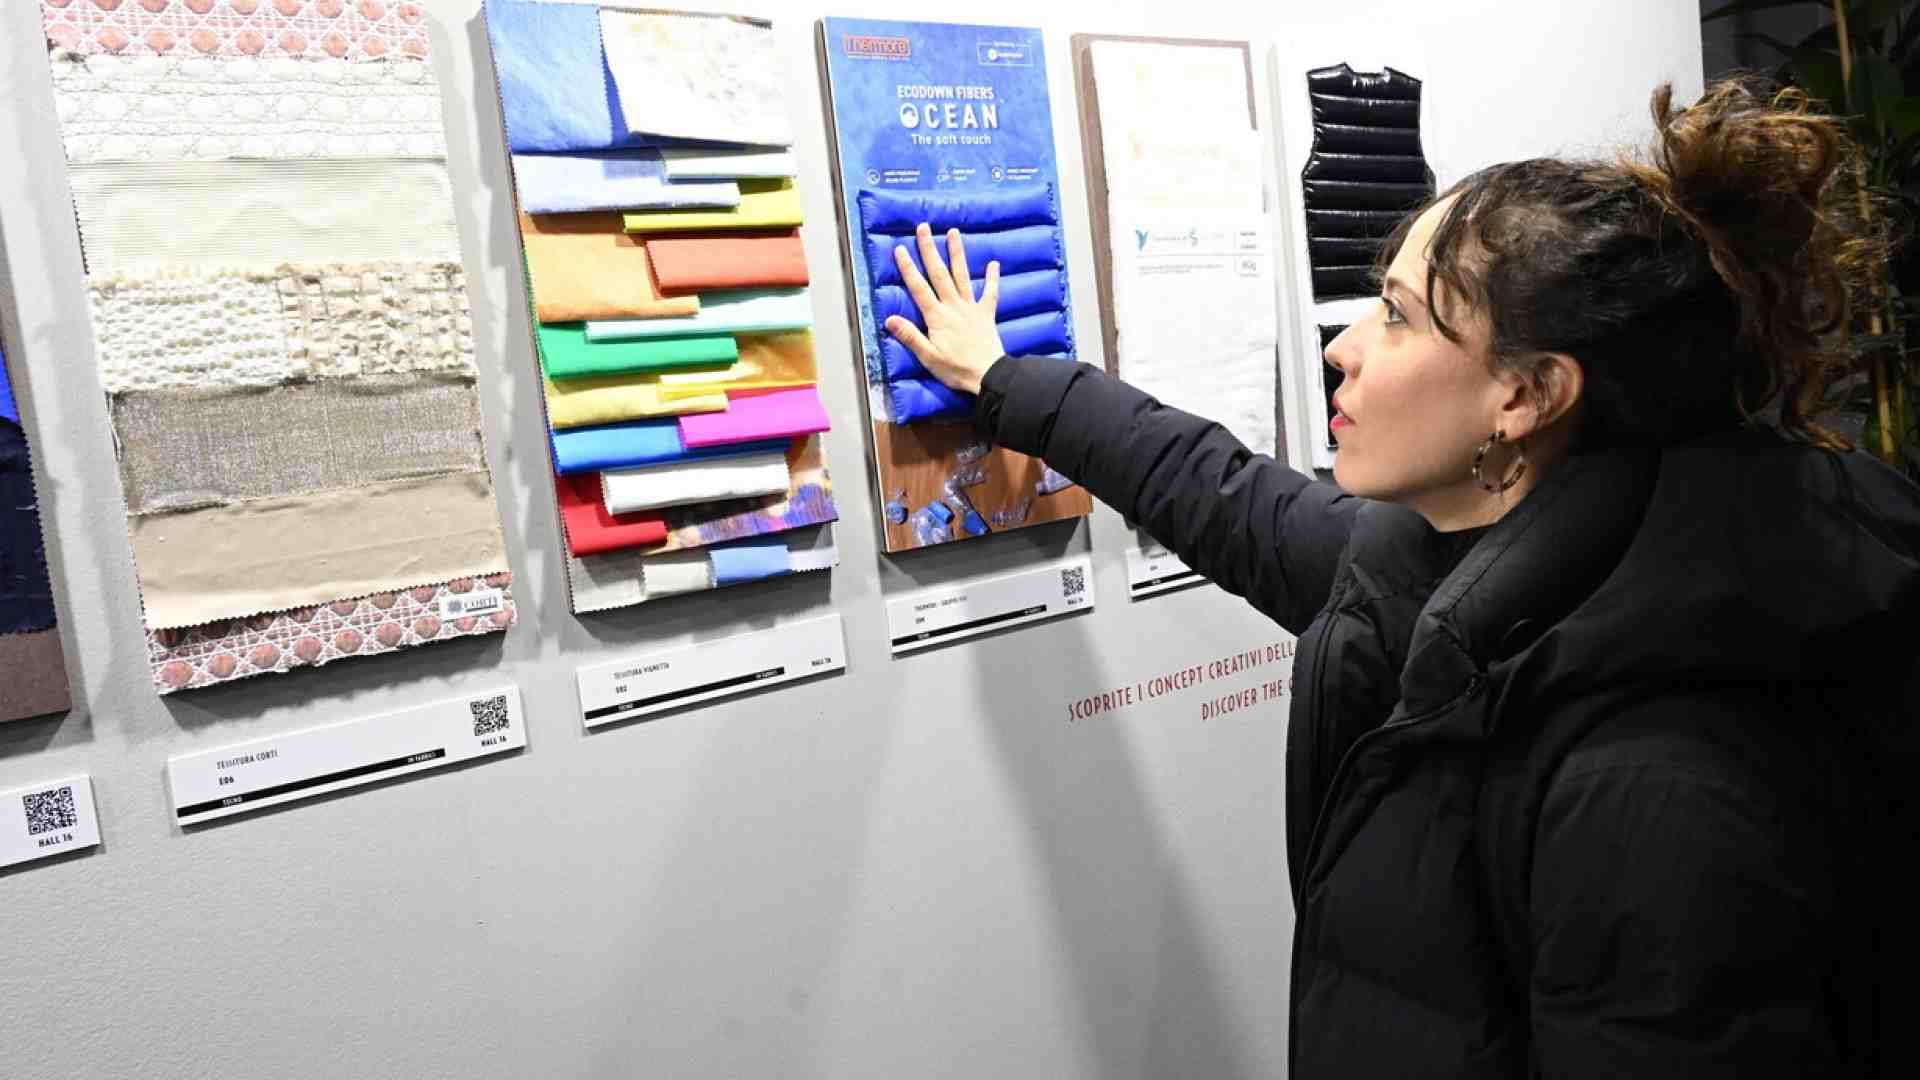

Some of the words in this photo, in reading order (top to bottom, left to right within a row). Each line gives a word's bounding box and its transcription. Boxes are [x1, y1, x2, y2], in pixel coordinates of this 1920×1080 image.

[897, 84, 953, 99] ECODOWN
[956, 86, 994, 100] FIBERS
[899, 102, 999, 128] OCEAN
[911, 133, 932, 145] The
[936, 133, 958, 145] soft
[960, 134, 992, 145] touch
[1068, 686, 1132, 721] SCOPRITE
[1138, 685, 1143, 701] I
[1147, 666, 1203, 698] CONCEPT
[1208, 649, 1262, 680] CREATIVI
[1202, 690, 1257, 720] DISCOVER
[1262, 679, 1283, 700] THE
[481, 738, 497, 747] HALL
[38, 836, 60, 848] HALL
[63, 833, 73, 841] 16
